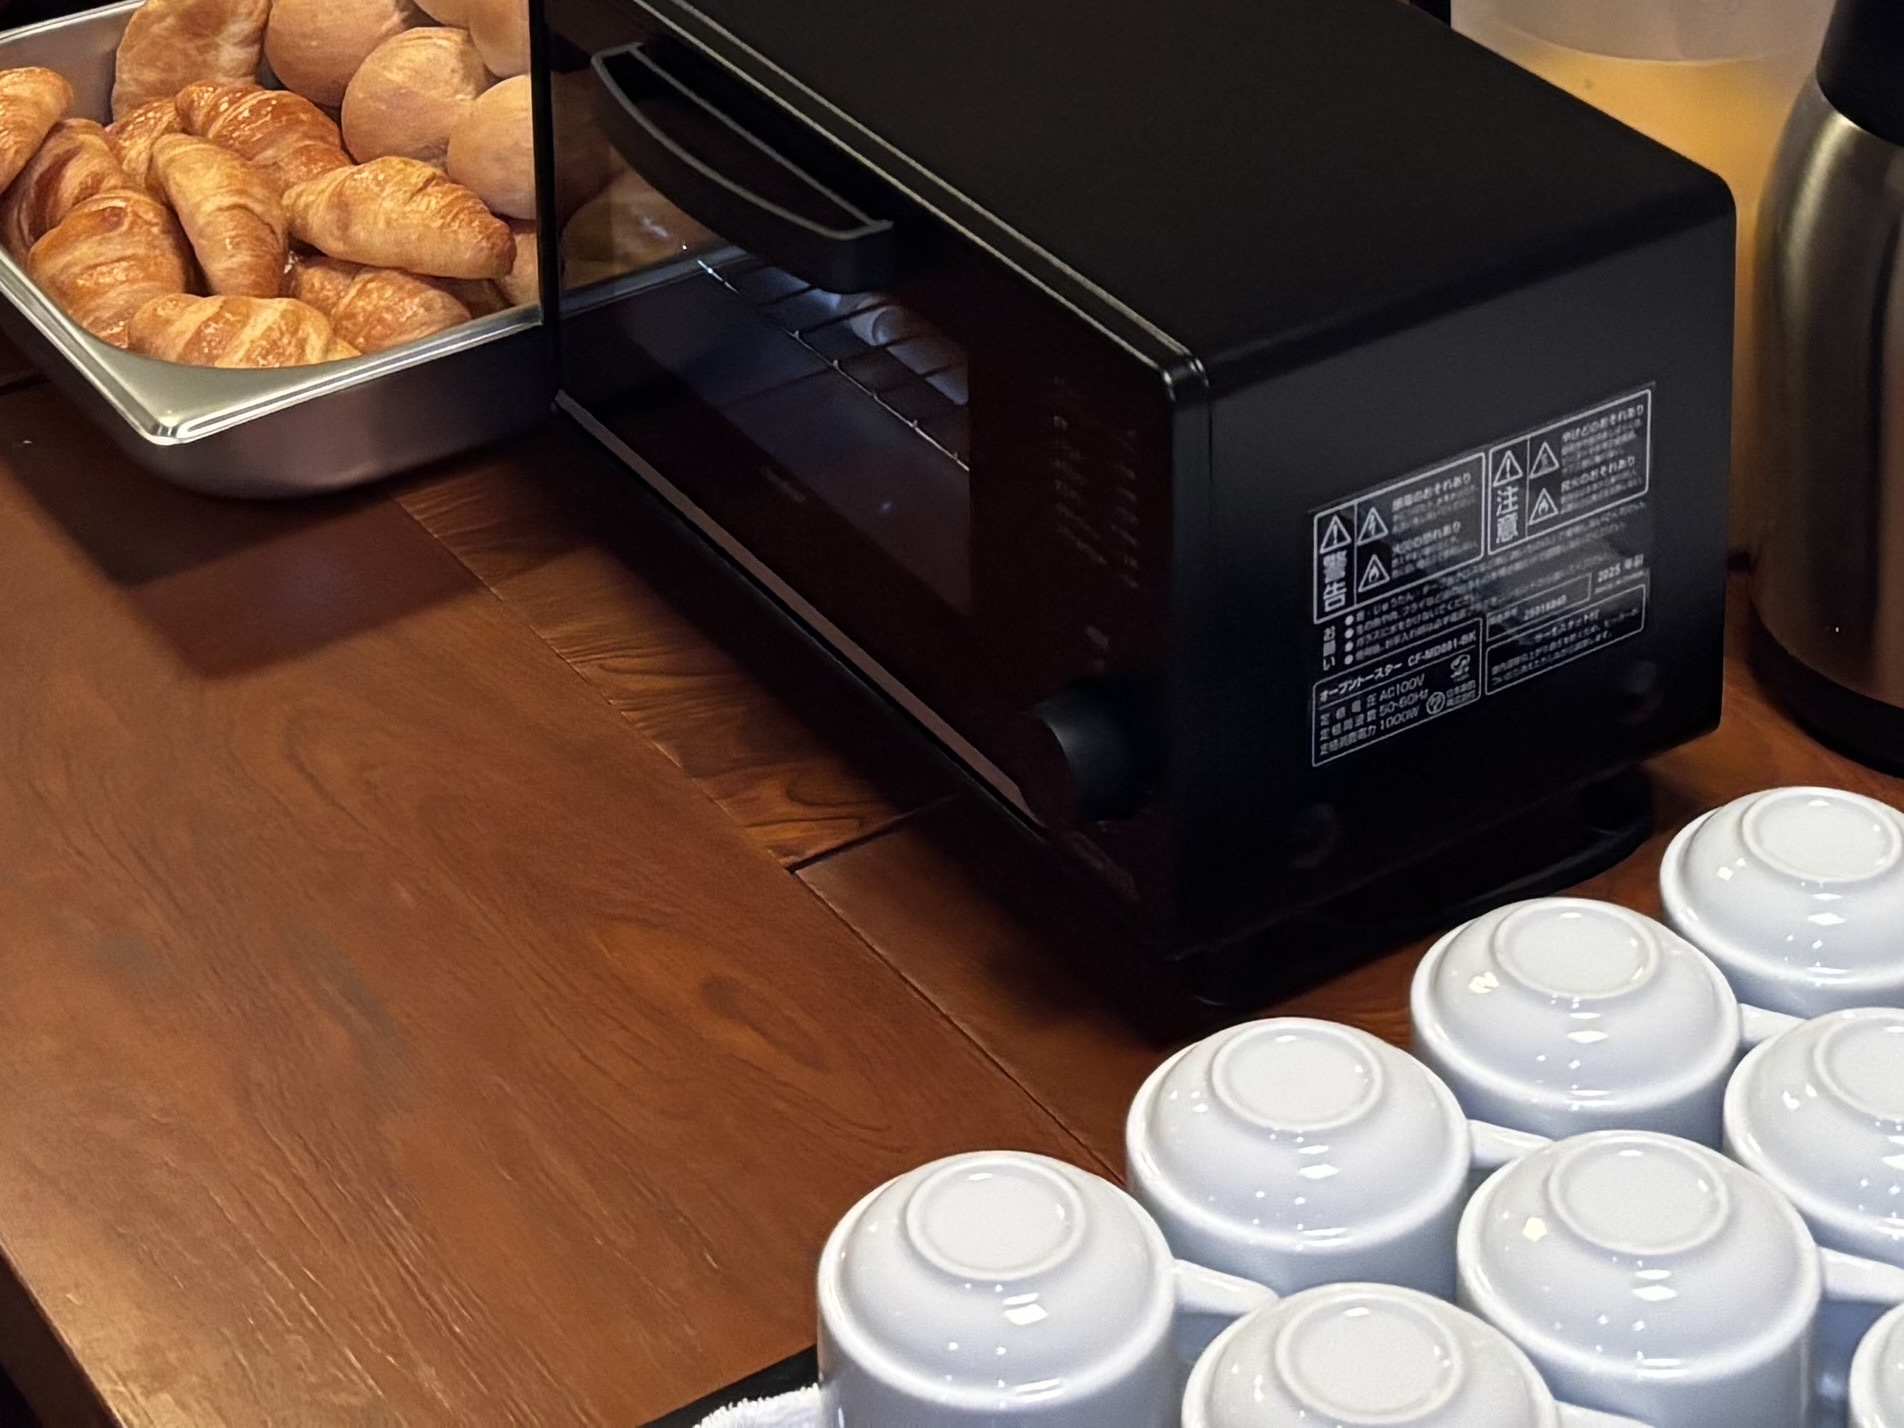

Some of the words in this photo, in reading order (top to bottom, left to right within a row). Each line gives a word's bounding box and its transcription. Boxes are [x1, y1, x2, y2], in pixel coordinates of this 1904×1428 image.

[1495, 481, 1519, 545] 注意
[1322, 547, 1347, 613] 警告
[1378, 673, 1425, 702] AC100V
[1379, 705, 1420, 731] 1000W
